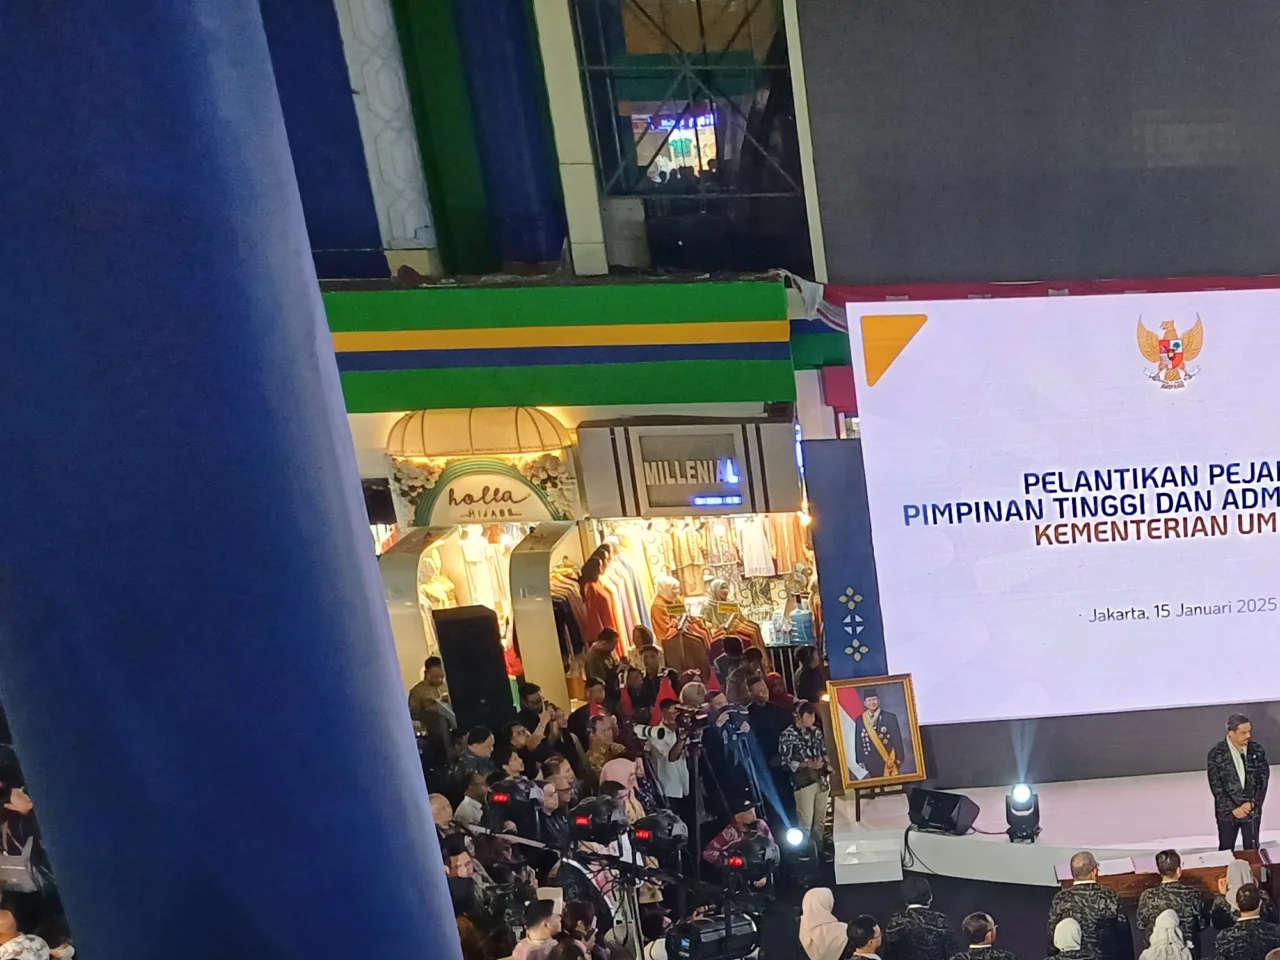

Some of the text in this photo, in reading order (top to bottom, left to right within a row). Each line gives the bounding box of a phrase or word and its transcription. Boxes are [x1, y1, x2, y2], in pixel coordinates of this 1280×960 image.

[643, 459, 740, 486] MILLENIAL
[1023, 464, 1198, 495] PELANTIKAN
[449, 486, 531, 506] holla
[903, 498, 1044, 526] PIMPINAN
[1053, 493, 1146, 519] TINGGI
[1156, 490, 1212, 514] DAN
[1034, 515, 1228, 546] KEMENTERIAN
[1089, 597, 1278, 623] Jakarta, 15 Januari 2025
